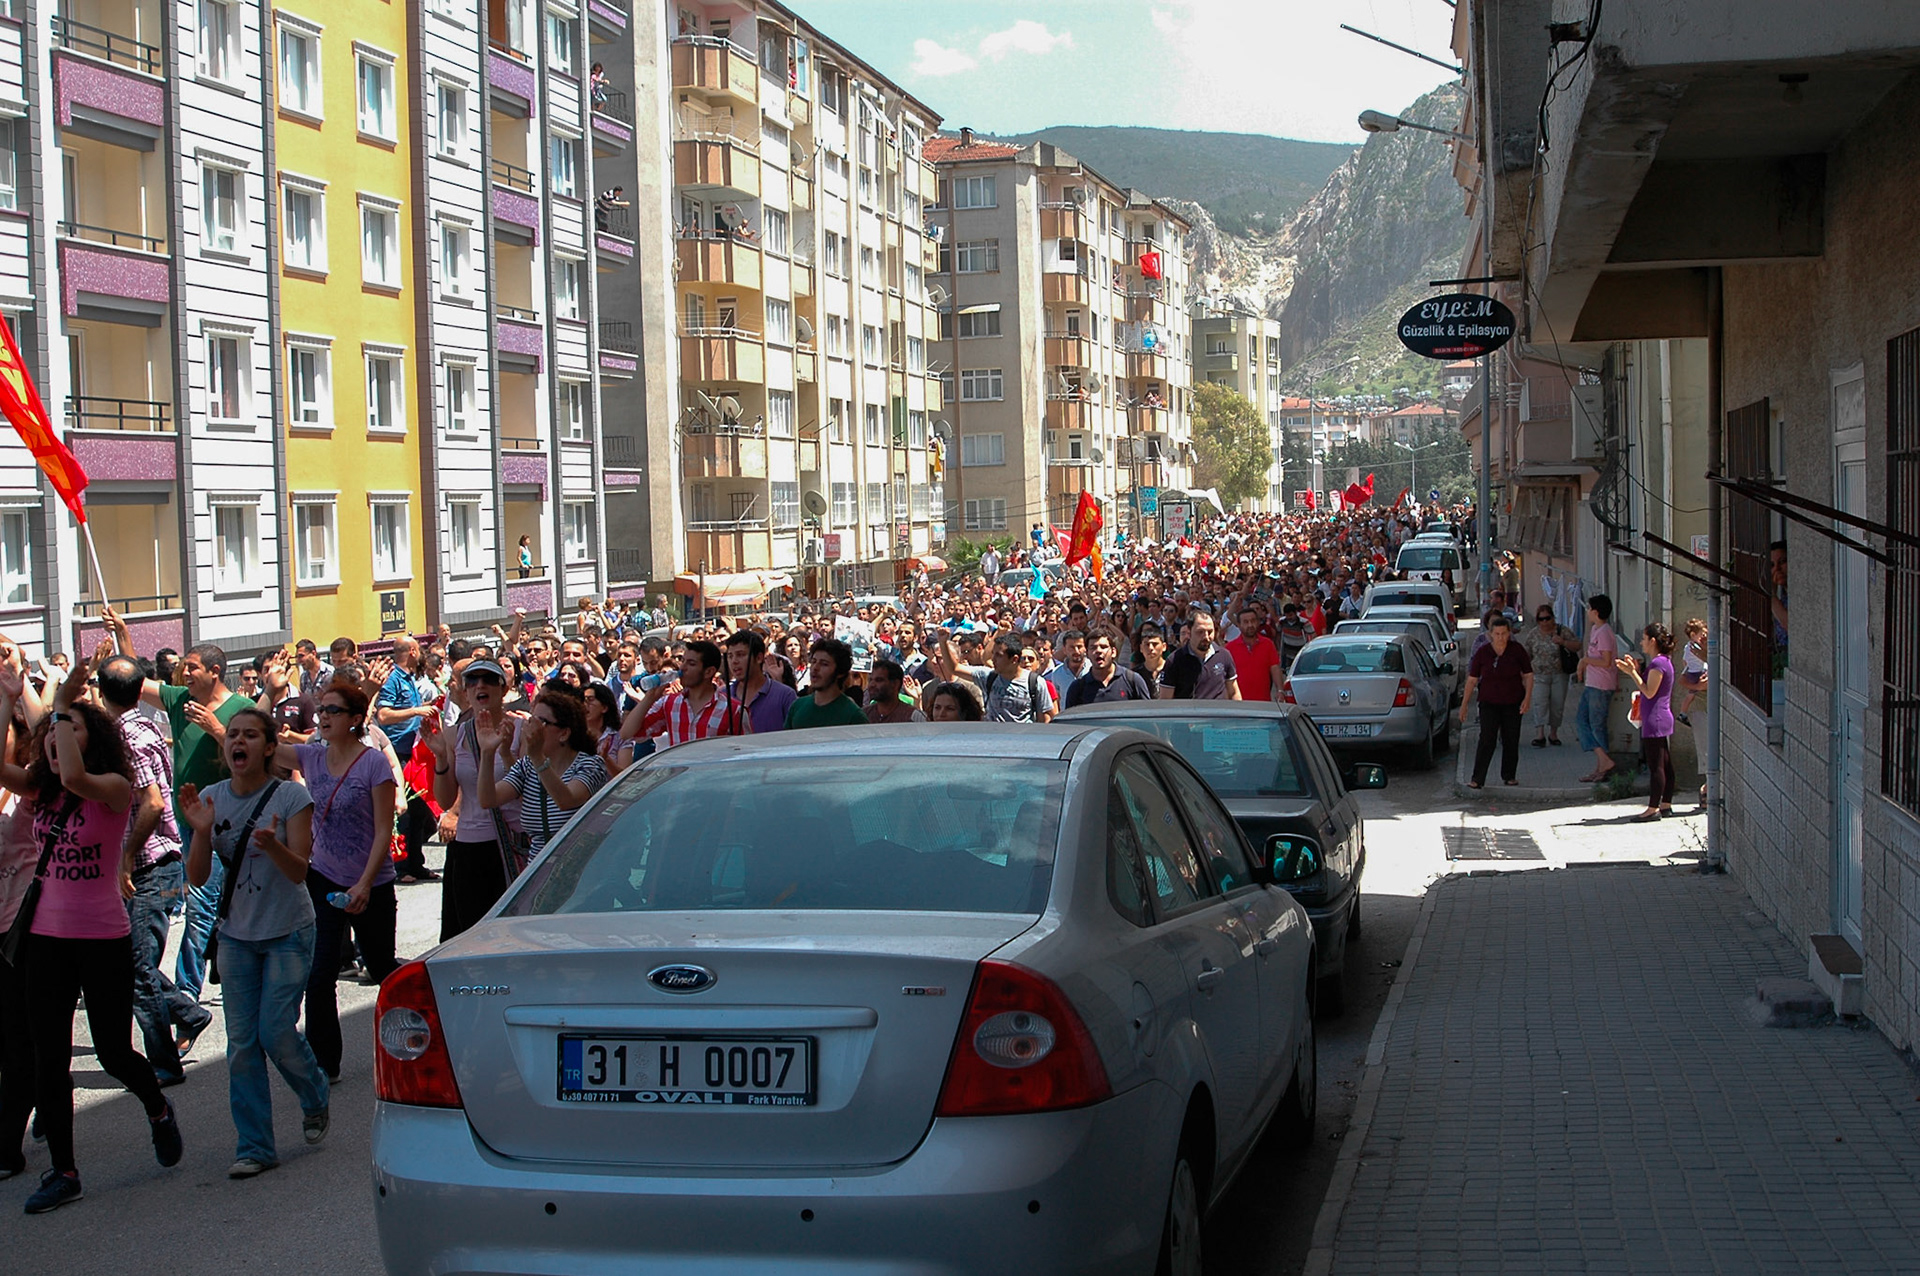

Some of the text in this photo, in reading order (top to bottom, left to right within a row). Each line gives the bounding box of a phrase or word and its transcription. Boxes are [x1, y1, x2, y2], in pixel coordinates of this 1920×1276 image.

[1420, 300, 1493, 323] EYLEM
[1402, 324, 1510, 338] Güzellik & Epilasyon
[1324, 724, 1368, 735] 31 HZ 134
[661, 969, 698, 986] Ford
[449, 984, 511, 997] FOCUS
[587, 1044, 796, 1089] 31 H 0007
[564, 1068, 581, 1081] TR
[583, 1092, 598, 1102] 407
[599, 1092, 608, 1102] 71
[610, 1092, 620, 1102] 71
[635, 1091, 734, 1105] OVALI
[748, 1094, 807, 1107] Fark Yaratır.
